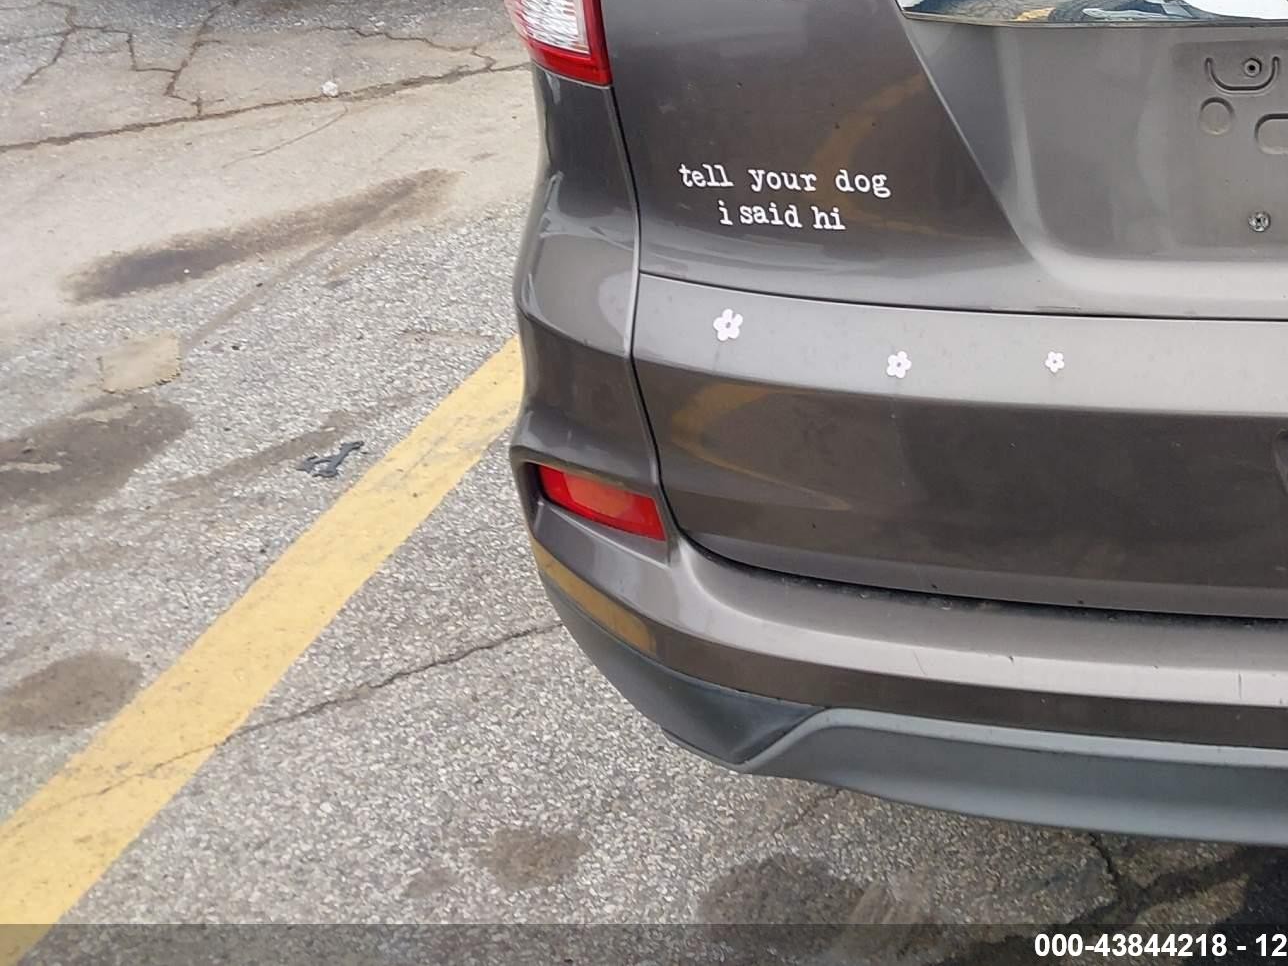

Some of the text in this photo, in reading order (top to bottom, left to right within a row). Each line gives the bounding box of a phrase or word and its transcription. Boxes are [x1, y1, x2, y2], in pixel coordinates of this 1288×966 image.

[678, 163, 891, 198] tell your dog
[718, 199, 846, 230] i said hi
